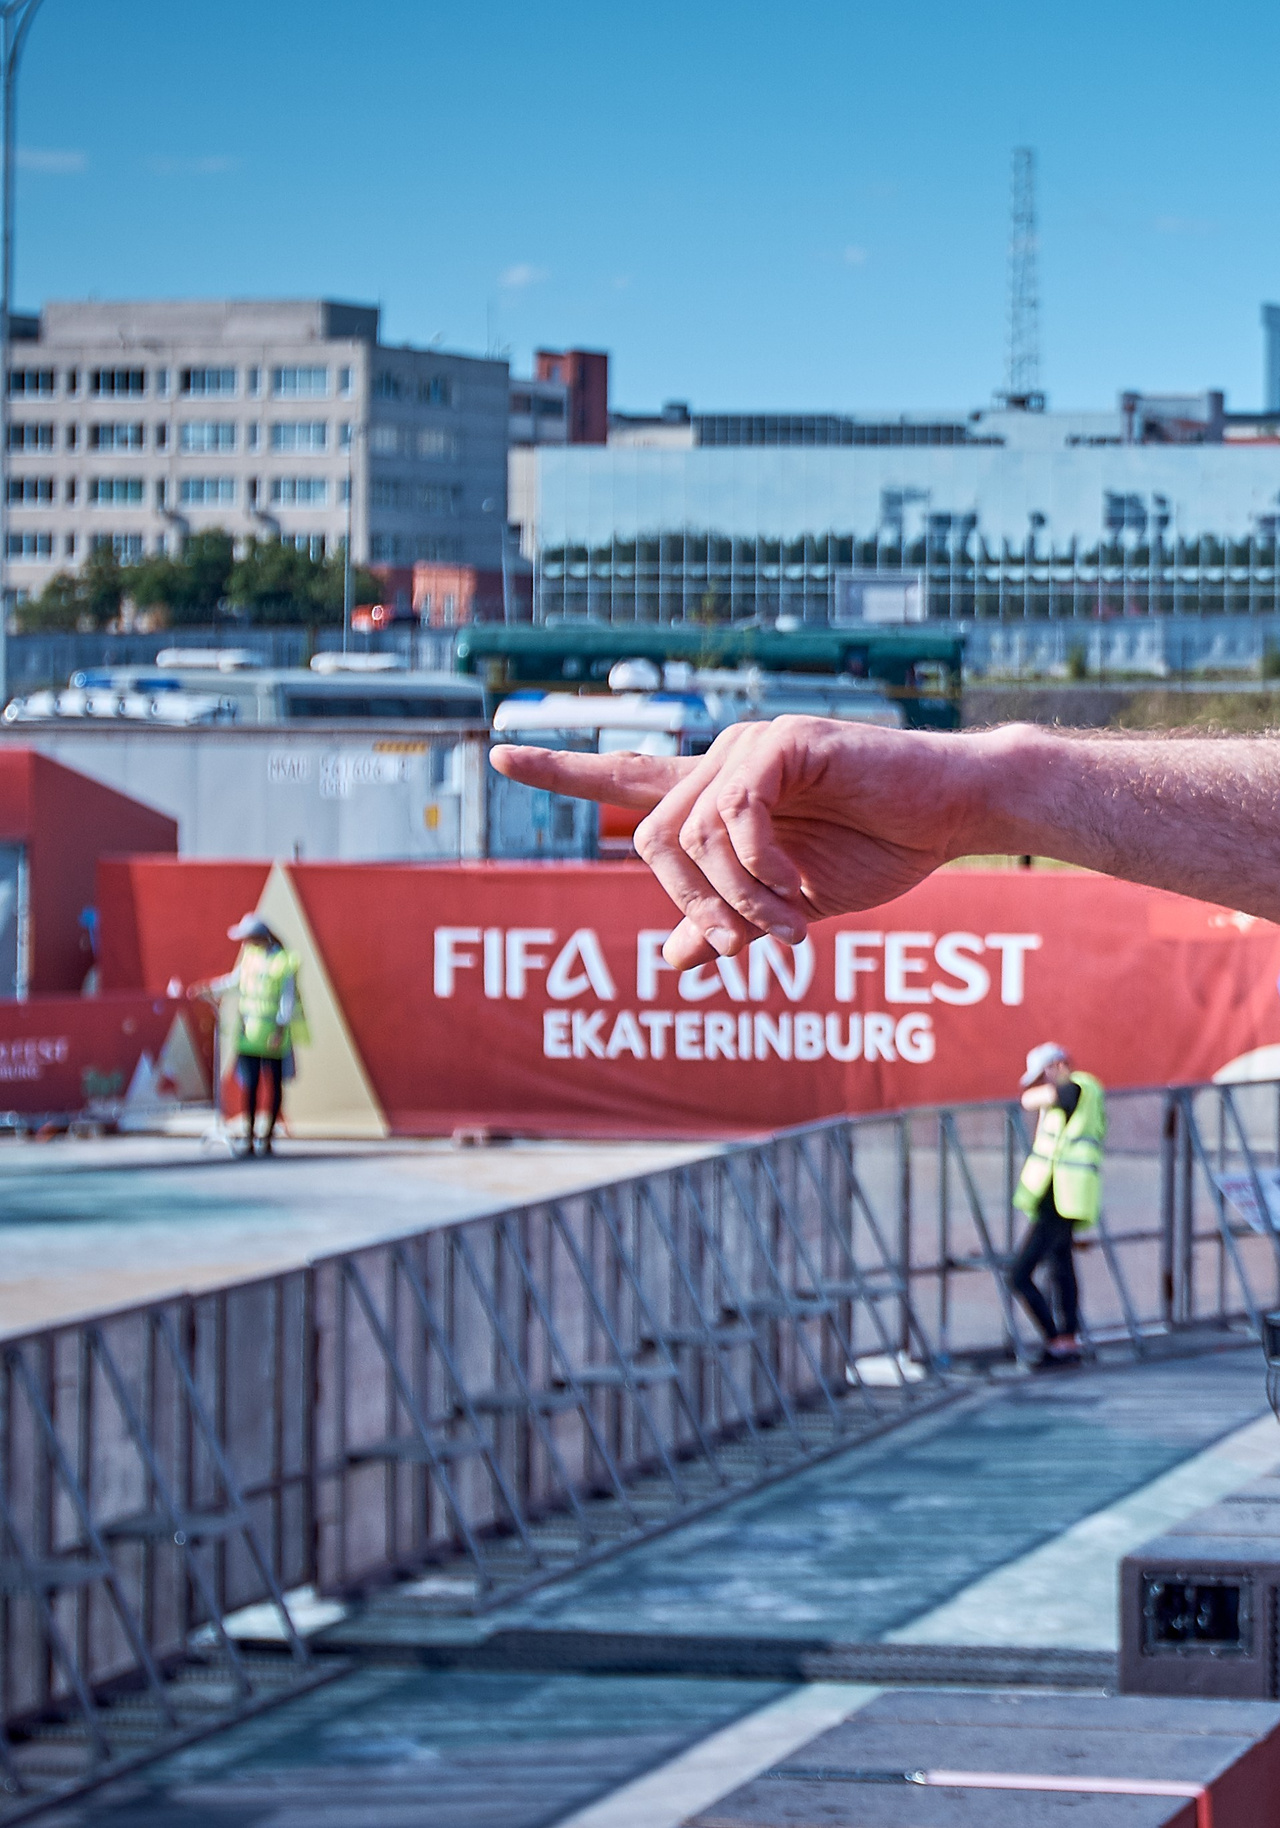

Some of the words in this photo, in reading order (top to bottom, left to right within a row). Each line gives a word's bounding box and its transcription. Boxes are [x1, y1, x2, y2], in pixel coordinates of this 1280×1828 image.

[434, 927, 614, 1000] FIFA
[835, 931, 1043, 1005] FEST
[544, 1010, 935, 1063] EKATERINBURG
